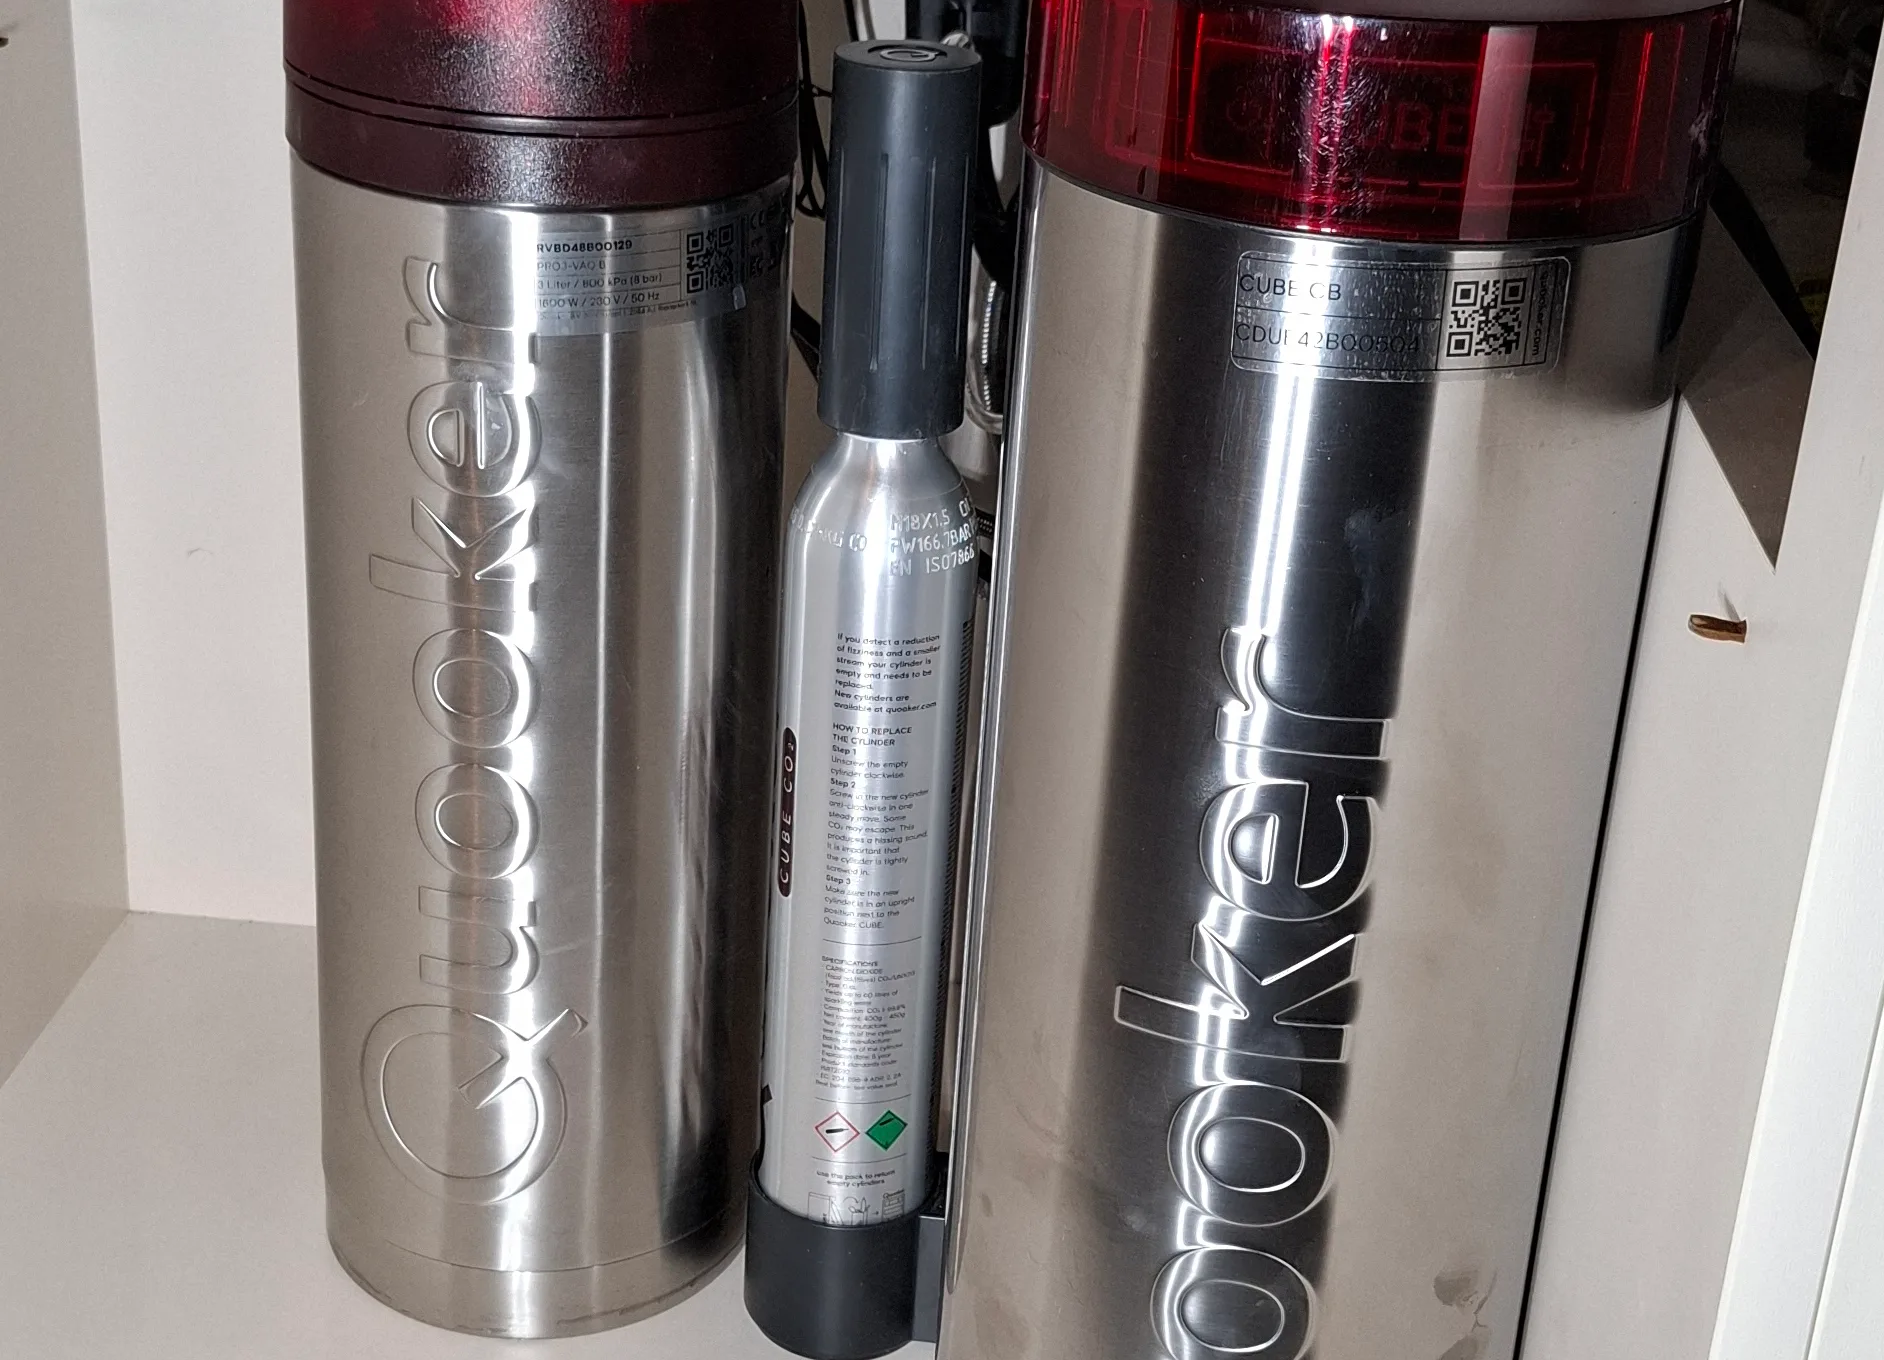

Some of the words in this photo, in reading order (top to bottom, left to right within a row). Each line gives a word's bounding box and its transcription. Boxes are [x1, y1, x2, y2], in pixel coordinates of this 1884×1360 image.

[547, 278, 571, 290] Liter
[582, 277, 604, 289] 800
[608, 274, 627, 287] kPa
[642, 272, 662, 285] bar)
[1239, 273, 1299, 297] CUBE
[1308, 281, 1342, 301] CB
[540, 297, 565, 309] 1600
[569, 296, 580, 307] W
[590, 295, 611, 307] 230
[613, 294, 621, 305] V
[631, 292, 645, 304] 50
[648, 290, 660, 301] Hz
[925, 542, 975, 574] ISO7866
[837, 632, 843, 641] If
[845, 636, 860, 644] you
[902, 634, 940, 646] reduction
[836, 644, 845, 653] of
[847, 645, 883, 657] fizziness
[886, 648, 903, 657] and
[836, 656, 864, 667] stream
[868, 661, 886, 670] your
[889, 659, 923, 671] cylinder
[925, 657, 932, 666] is
[835, 668, 862, 679] empty
[863, 671, 881, 680] and
[883, 671, 909, 680] needs
[912, 671, 921, 679] to
[854, 692, 893, 702] cylinders
[361, 254, 588, 1206] Quooker
[832, 722, 854, 734] HOW
[856, 726, 869, 735] TO
[871, 726, 913, 736] REPLACE
[832, 733, 849, 744] THE
[850, 737, 896, 747] CYLINDER
[832, 744, 851, 756] Step
[867, 760, 881, 769] the
[883, 761, 908, 770] empty
[830, 777, 850, 789] Step
[865, 793, 879, 801] the
[889, 803, 896, 811] in
[845, 825, 862, 834] may
[875, 835, 903, 845] hissing
[780, 810, 792, 884] CUBE
[884, 845, 900, 854] that
[825, 874, 845, 886] Step
[867, 889, 881, 897] the
[877, 911, 885, 919] to
